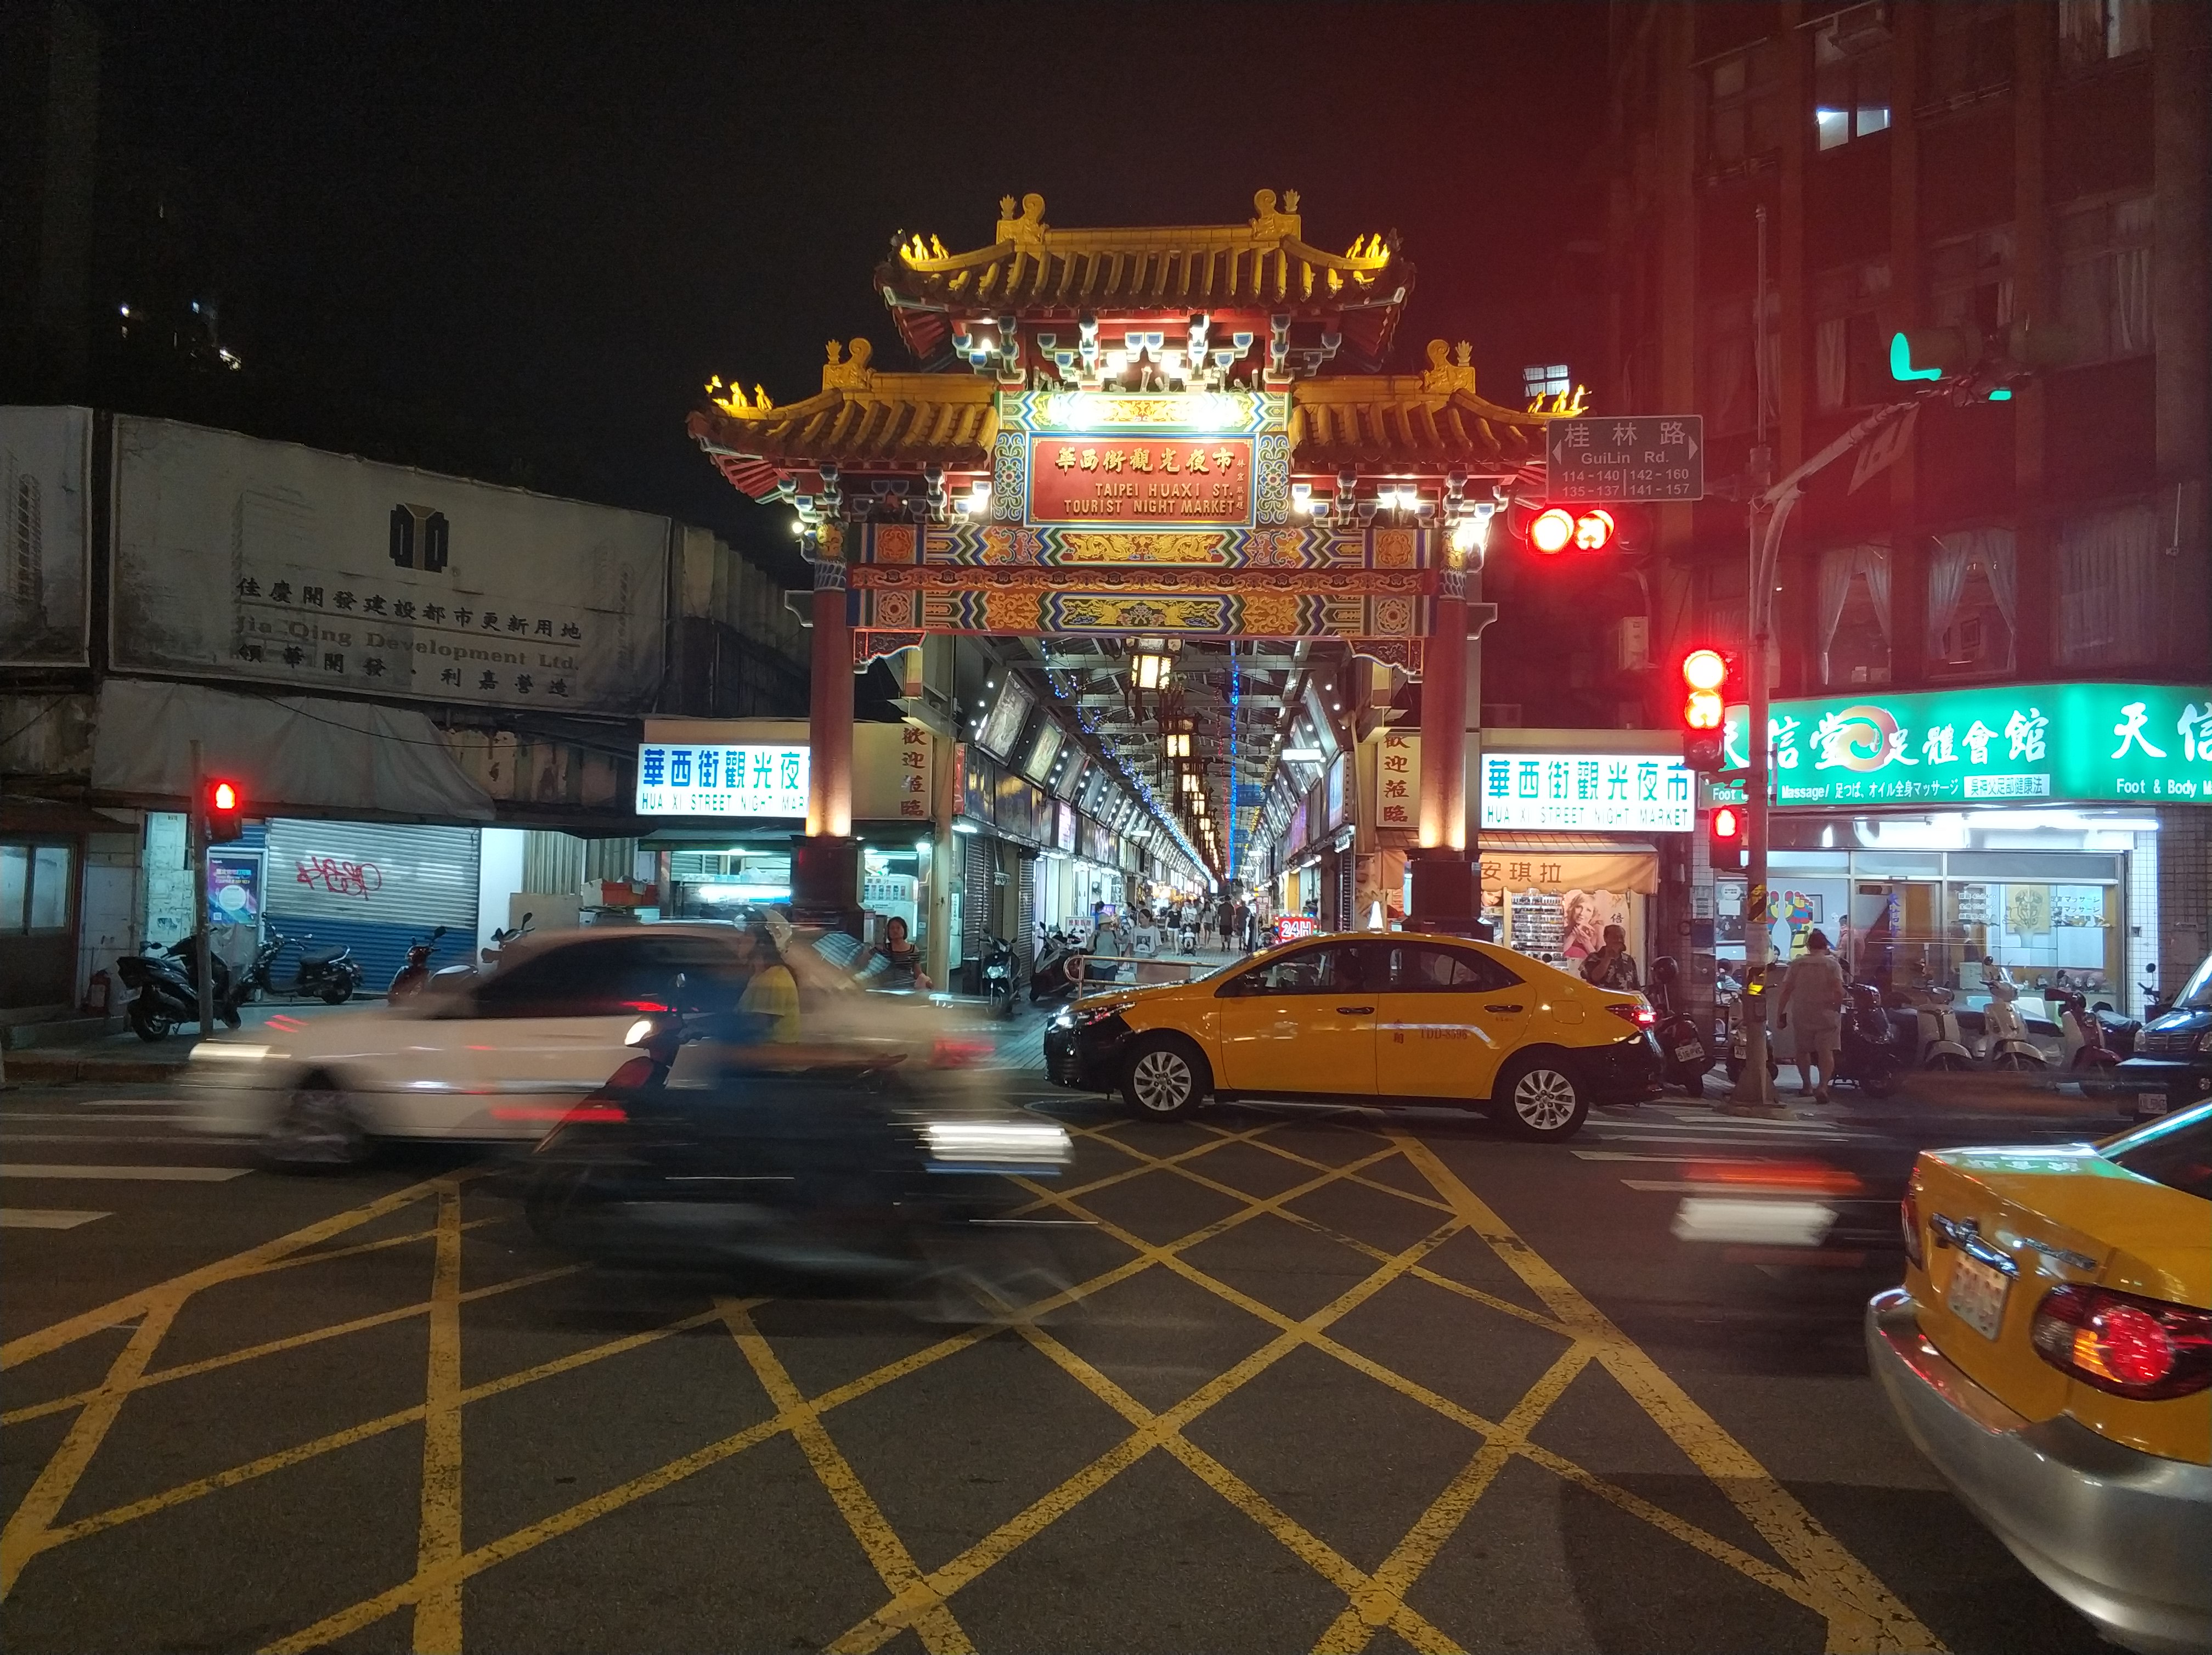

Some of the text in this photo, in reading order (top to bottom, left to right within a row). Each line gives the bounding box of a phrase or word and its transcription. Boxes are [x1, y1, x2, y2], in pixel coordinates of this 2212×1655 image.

[1565, 421, 1685, 448] 桂林路
[1055, 446, 1234, 475] 華西街觀光夜市
[1581, 451, 1669, 465] GuiLin Rd.
[1095, 483, 1233, 498] TAIPEI HUAXI ST.
[1064, 499, 1235, 515] TOURIST NIGHT MARKET
[236, 615, 580, 671] Jia Qing Development Ltd.
[643, 748, 811, 789] 華西街觀光夜
[1383, 736, 1411, 823] 歡迎蒞臨
[1488, 760, 1689, 801] 華西街觀光夜市
[2117, 778, 2146, 794] Foot
[2153, 779, 2162, 795] &
[2168, 779, 2198, 799] Body
[642, 792, 809, 813] HUA XI STREET NIGHT MAR
[1712, 787, 1737, 801] Foot
[1487, 806, 1688, 826] HUA XI STREET NIGHT MARKET
[1480, 860, 1562, 883] 安琪拉
[1281, 920, 1312, 937] 24H
[1610, 913, 1624, 923] 倍
